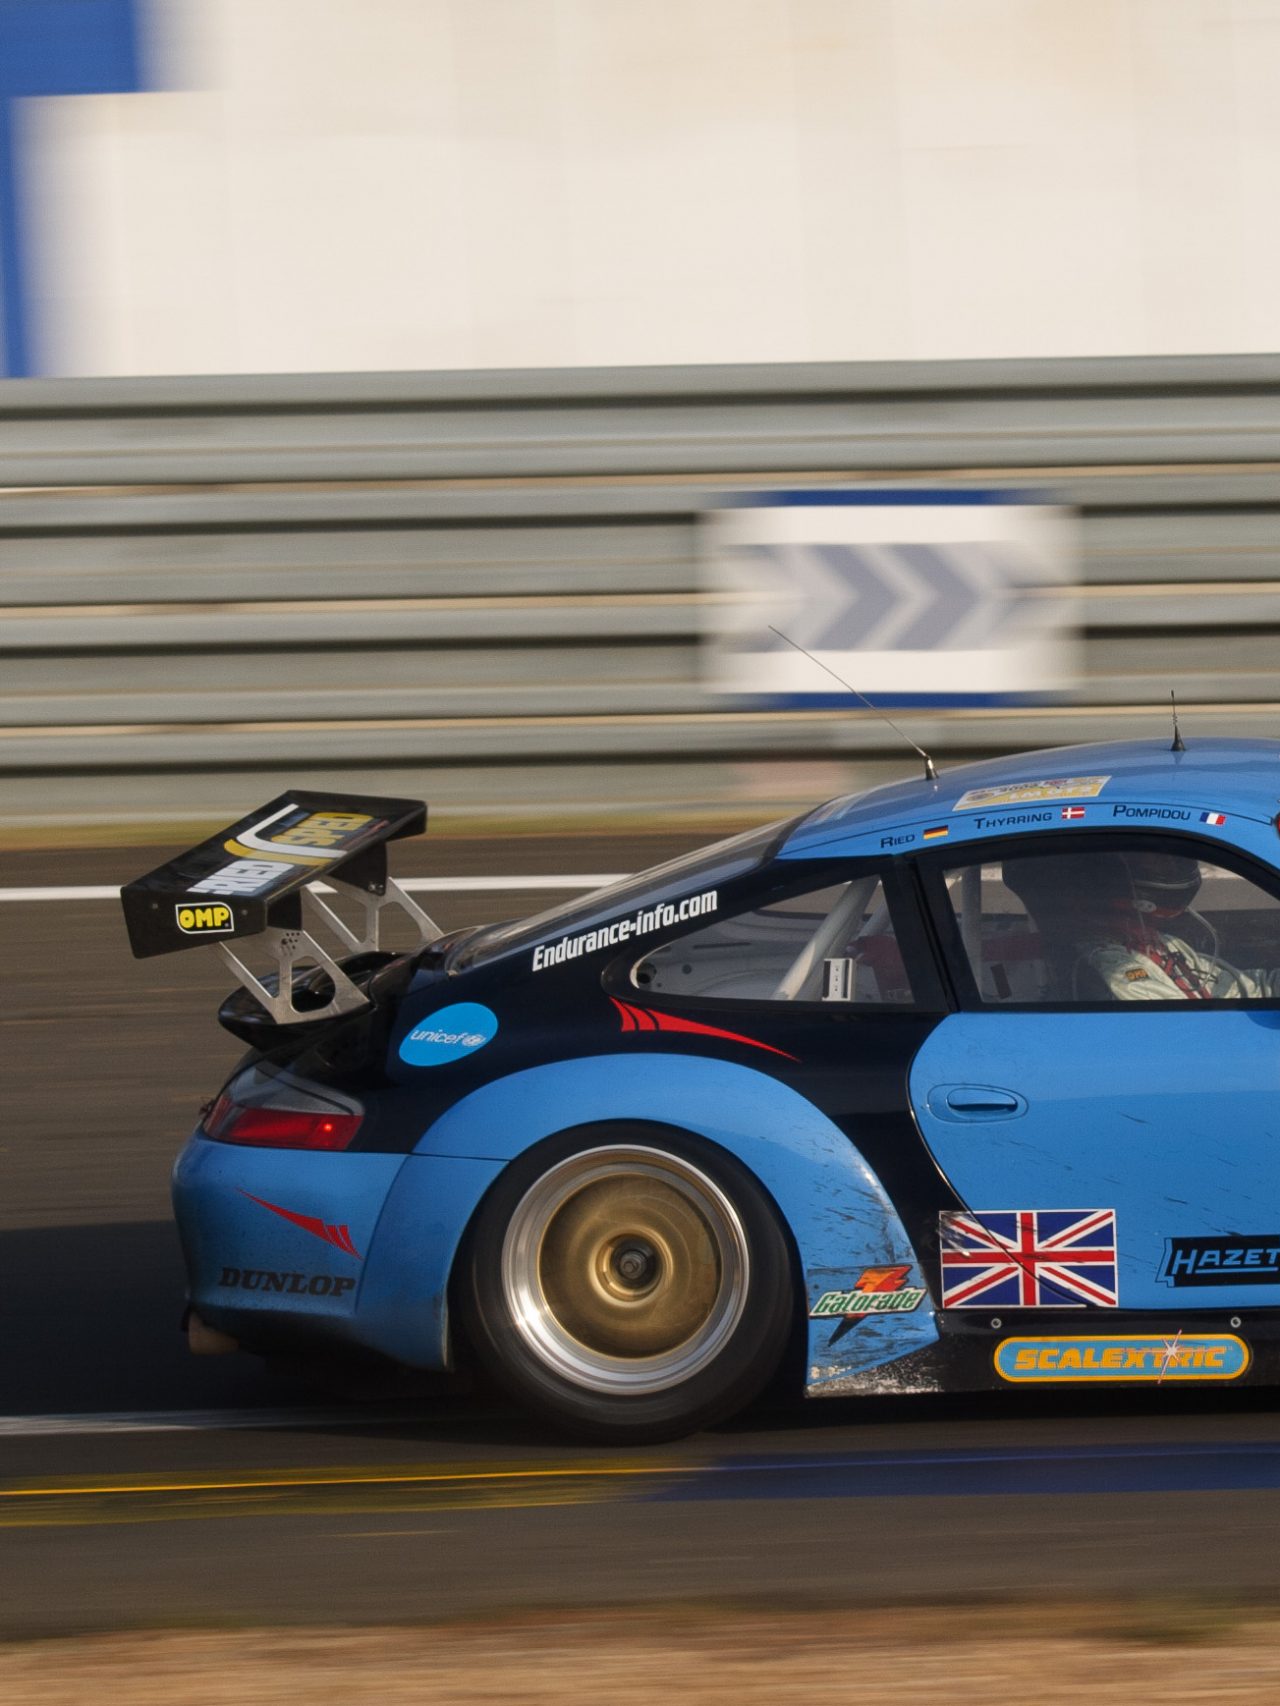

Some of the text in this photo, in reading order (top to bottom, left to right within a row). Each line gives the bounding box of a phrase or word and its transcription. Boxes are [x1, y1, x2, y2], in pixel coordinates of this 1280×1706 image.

[178, 905, 230, 929] OMP
[531, 889, 718, 972] Endurance-info.com
[410, 1028, 465, 1047] unicef
[218, 1266, 356, 1297] DUNLOP
[813, 1289, 922, 1314] Gatorade
[1013, 1345, 1227, 1371] SCALEXTRIC
